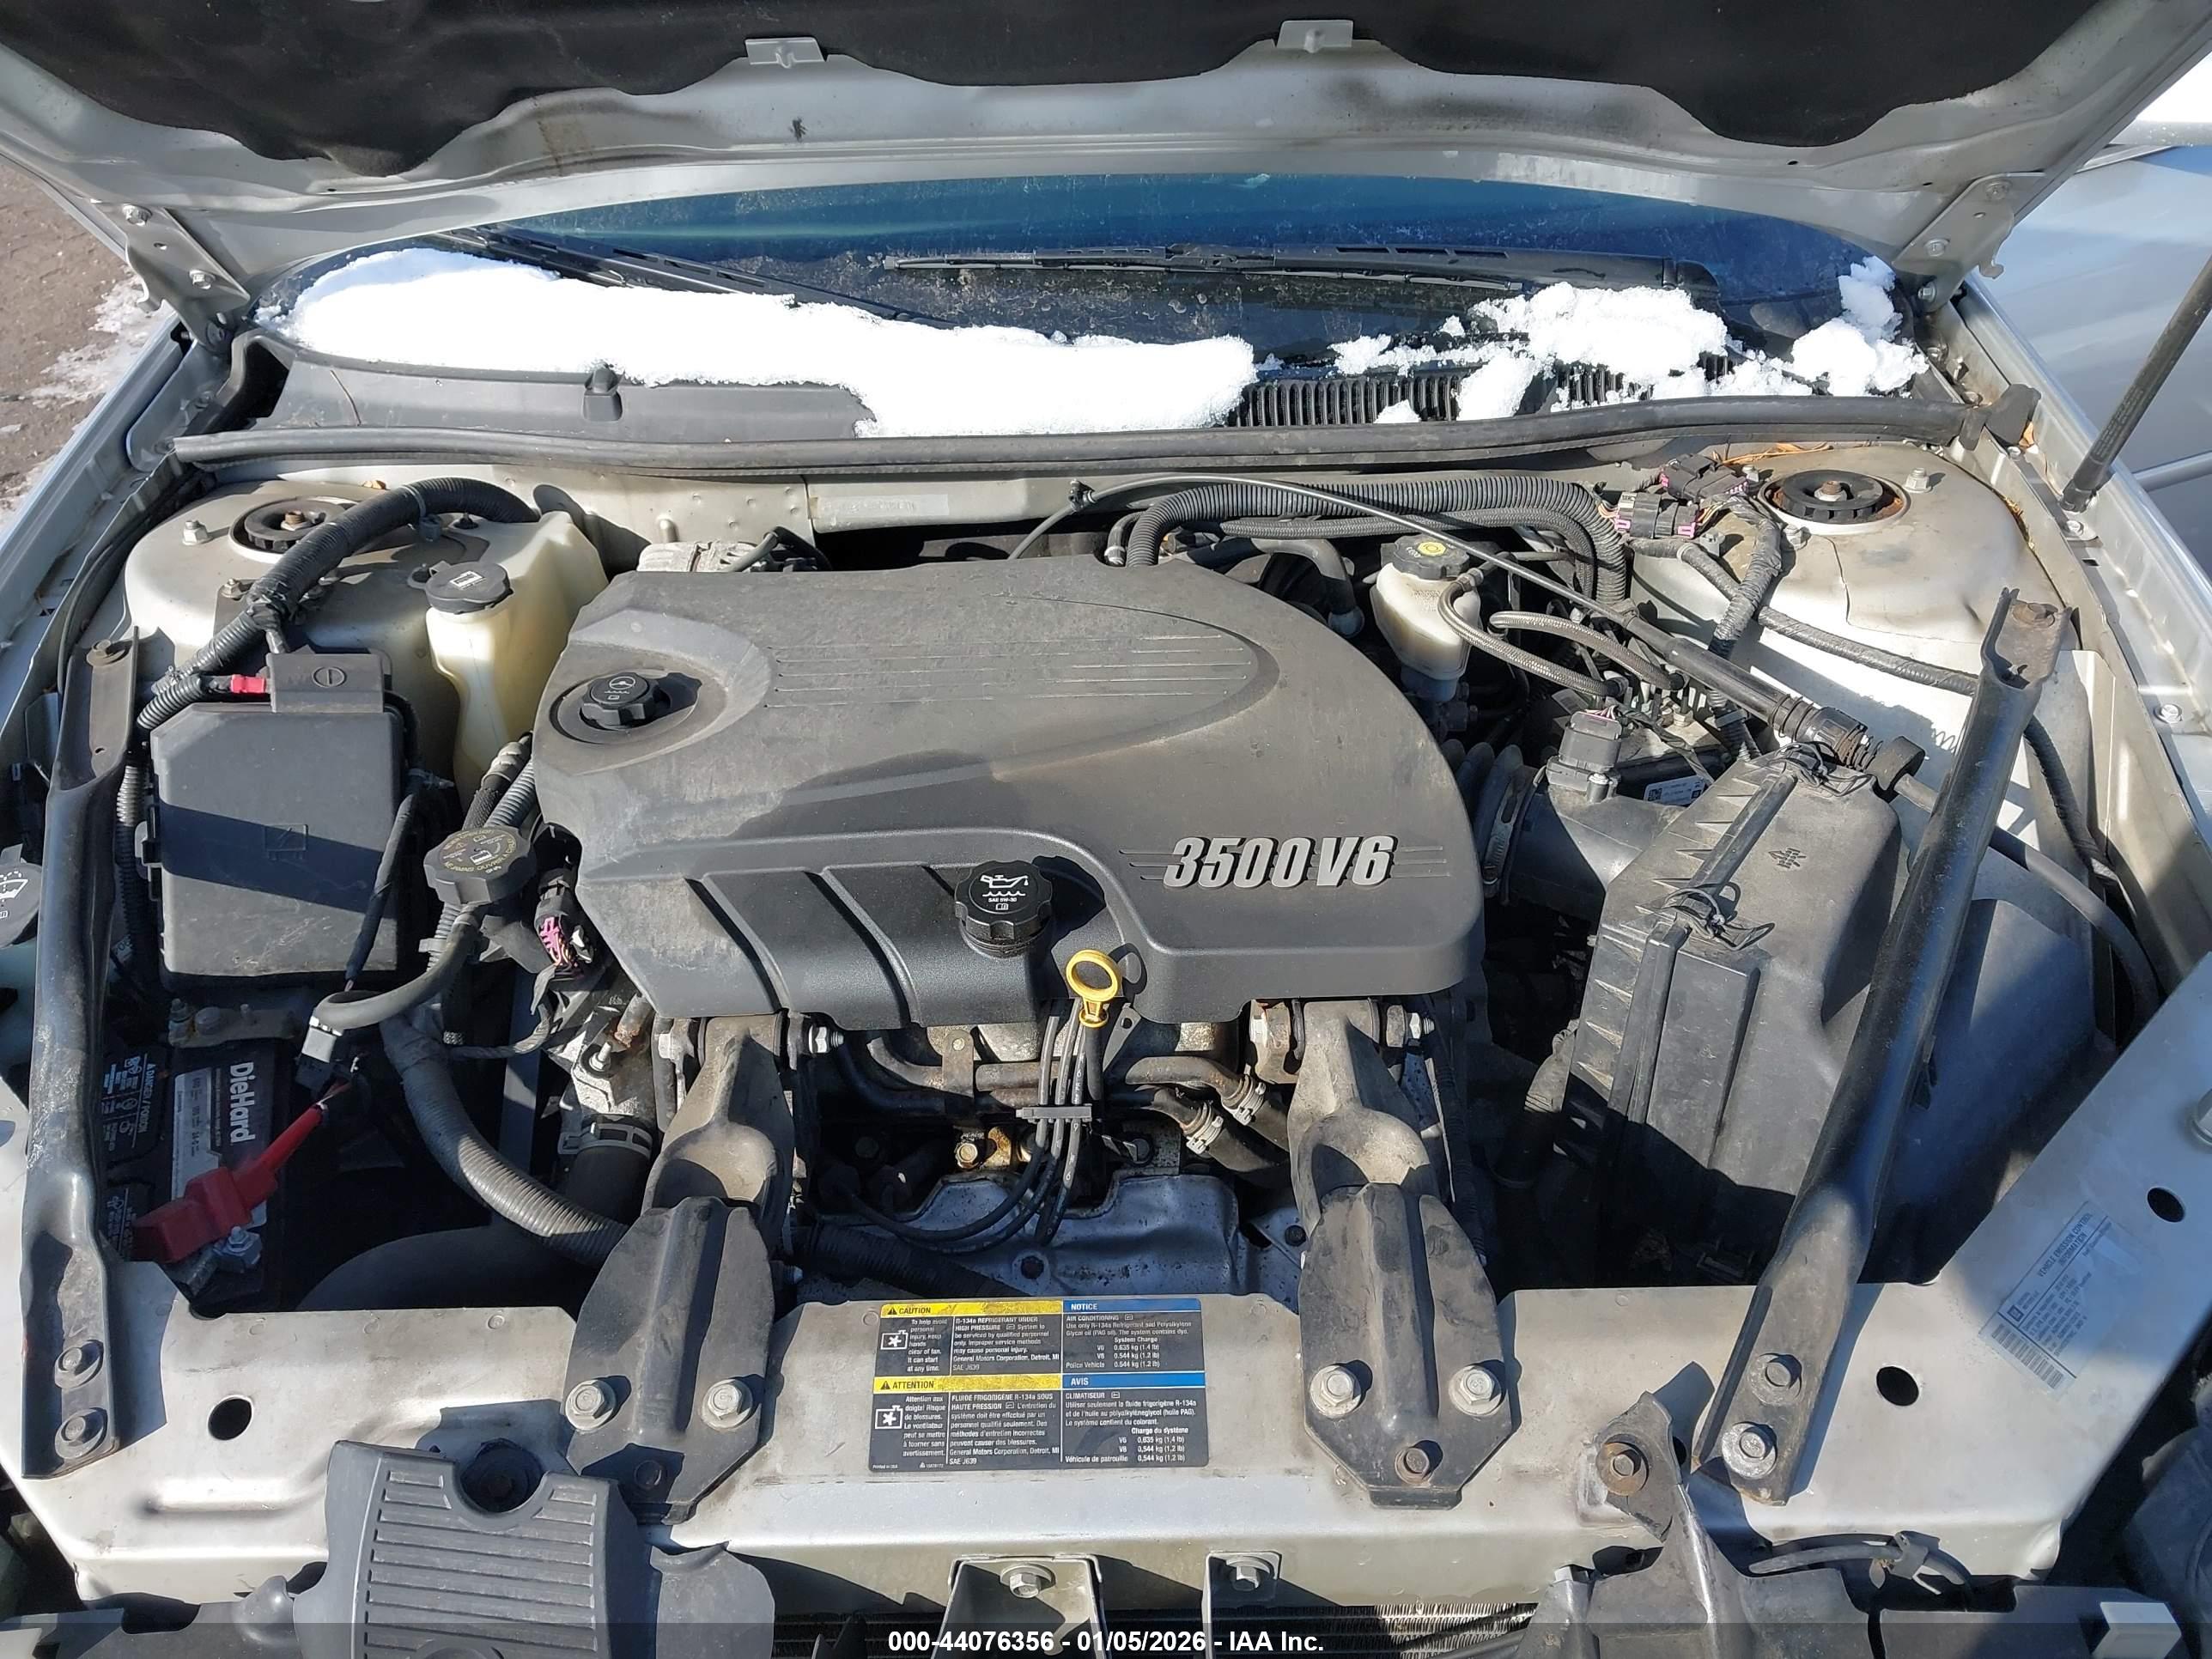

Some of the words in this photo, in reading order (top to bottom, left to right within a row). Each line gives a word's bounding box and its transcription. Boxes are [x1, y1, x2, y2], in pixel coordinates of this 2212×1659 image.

[1163, 836, 1312, 888] 3500
[1316, 836, 1397, 886] V6
[229, 1061, 256, 1143] DieHard
[2037, 1255, 2056, 1277] VEHICLE
[2053, 1234, 2075, 1257] EMISSION
